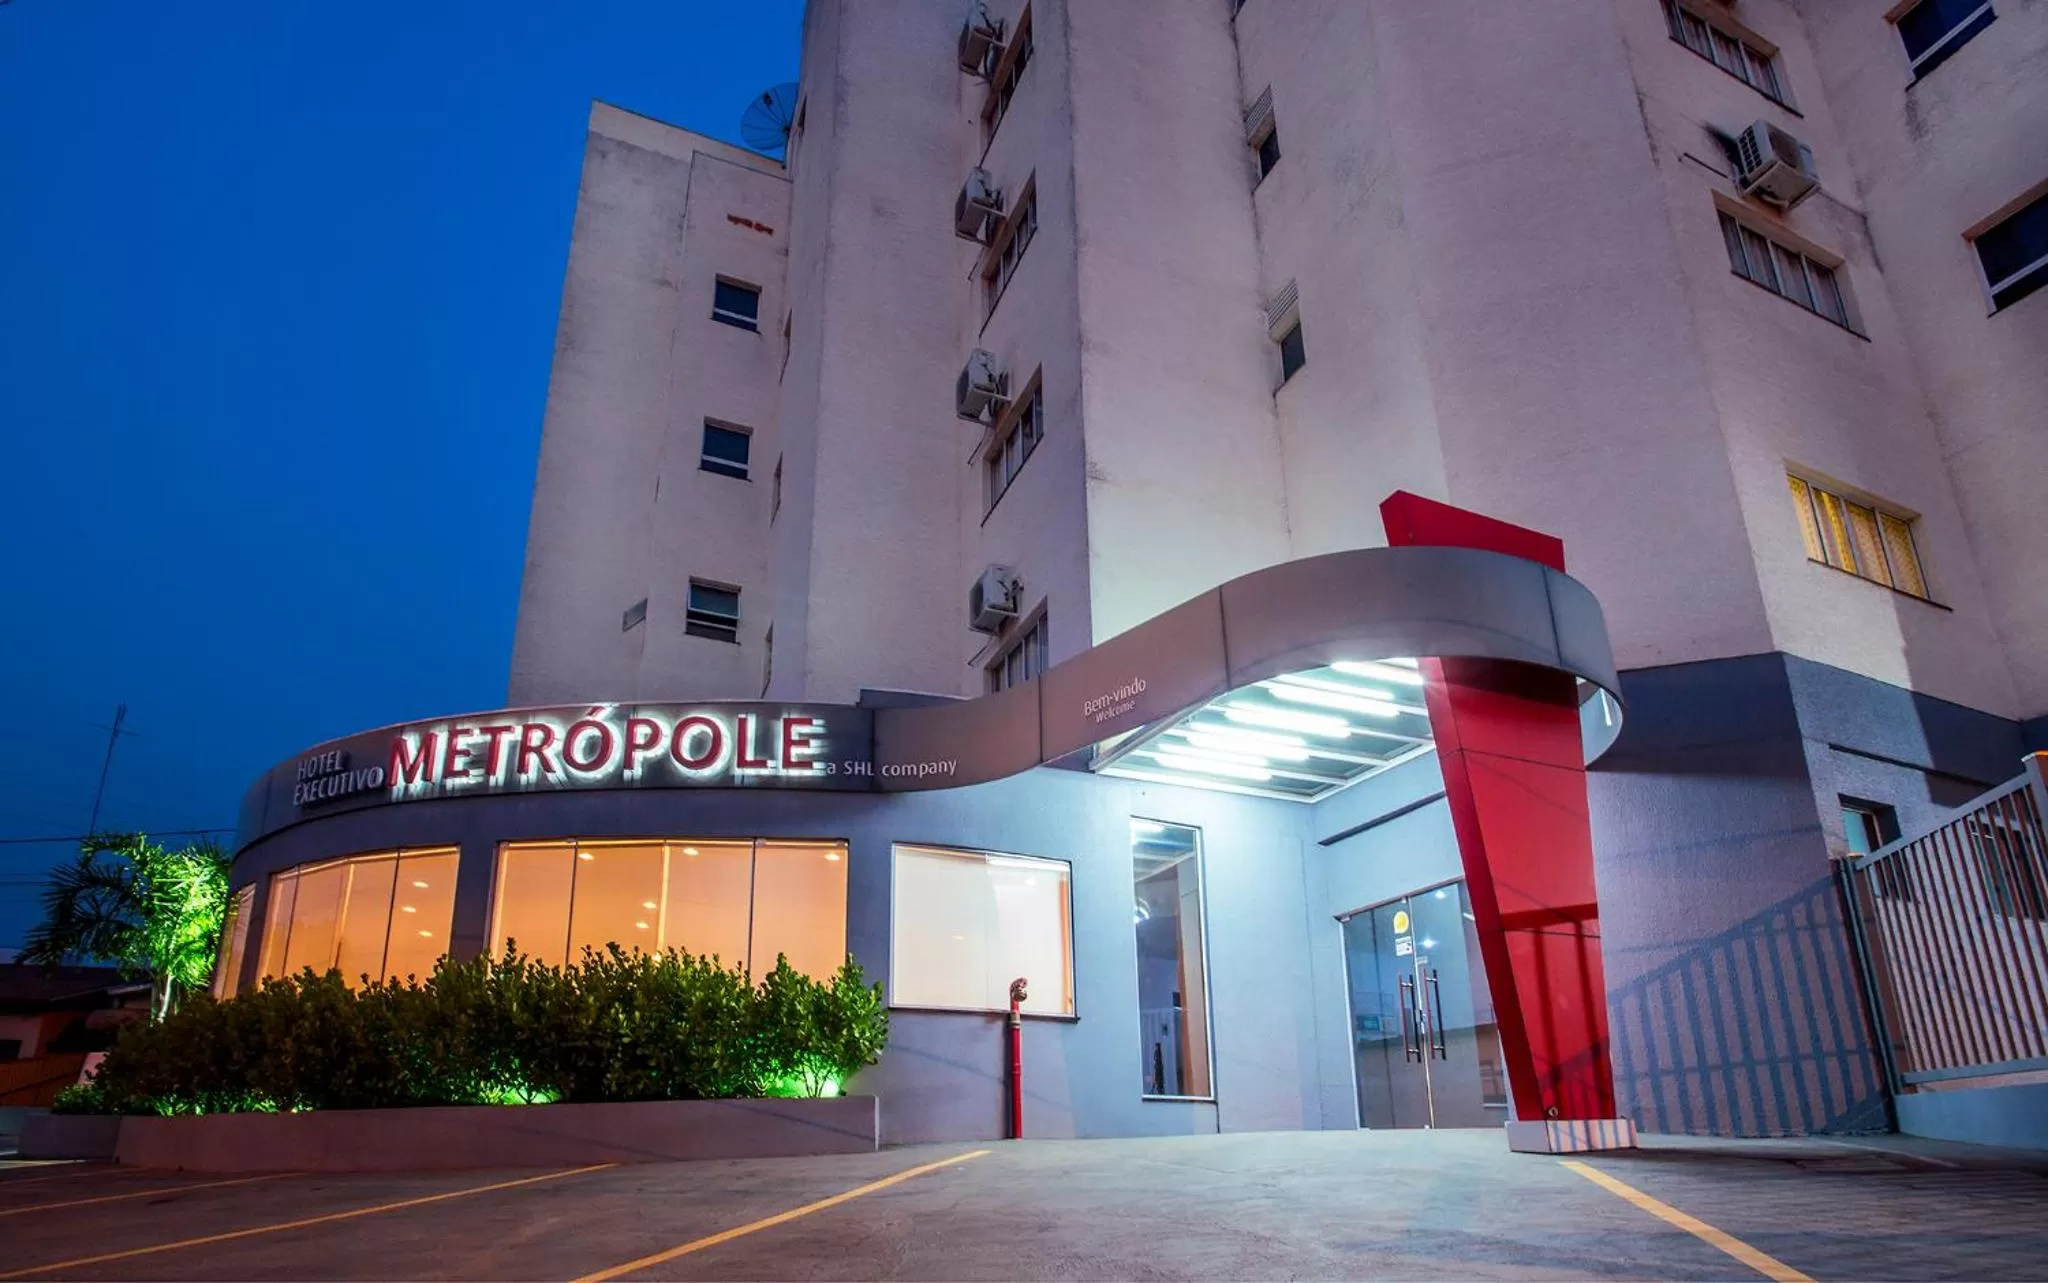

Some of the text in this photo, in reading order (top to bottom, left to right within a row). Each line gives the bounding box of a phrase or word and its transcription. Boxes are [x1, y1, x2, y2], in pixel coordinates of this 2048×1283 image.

[1084, 677, 1146, 716] Bem-vindo
[1096, 701, 1136, 723] Welcome
[387, 704, 816, 789] METRÓPOLE
[299, 750, 344, 781] HOTEL
[827, 759, 957, 779] a SHL company
[294, 766, 384, 805] EXECUTIVO
